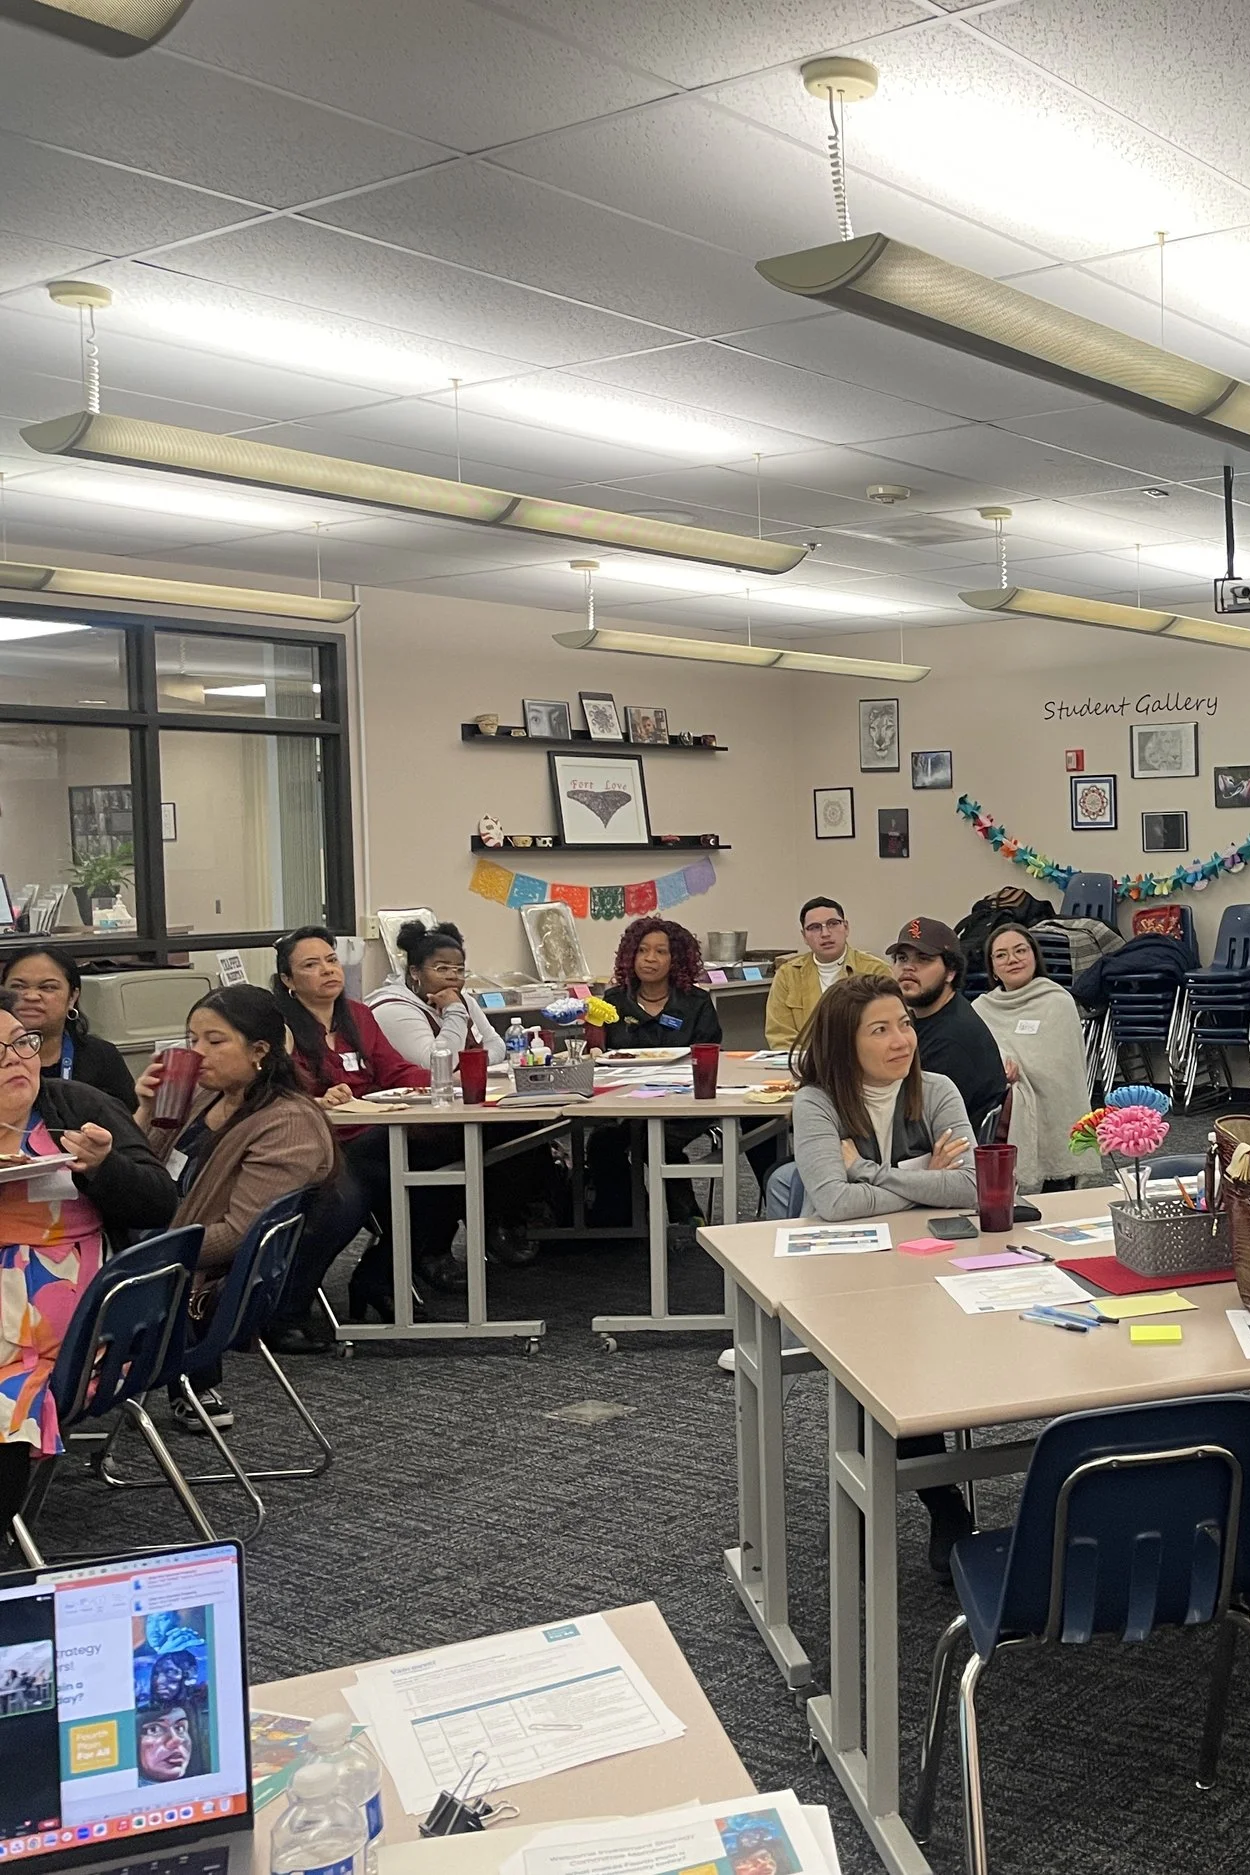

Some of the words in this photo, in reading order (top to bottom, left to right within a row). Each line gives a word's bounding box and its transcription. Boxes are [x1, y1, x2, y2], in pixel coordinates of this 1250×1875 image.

[1044, 697, 1130, 720] Student
[1135, 692, 1218, 716] Gallery
[570, 779, 594, 789] Fort
[605, 780, 627, 790] Love
